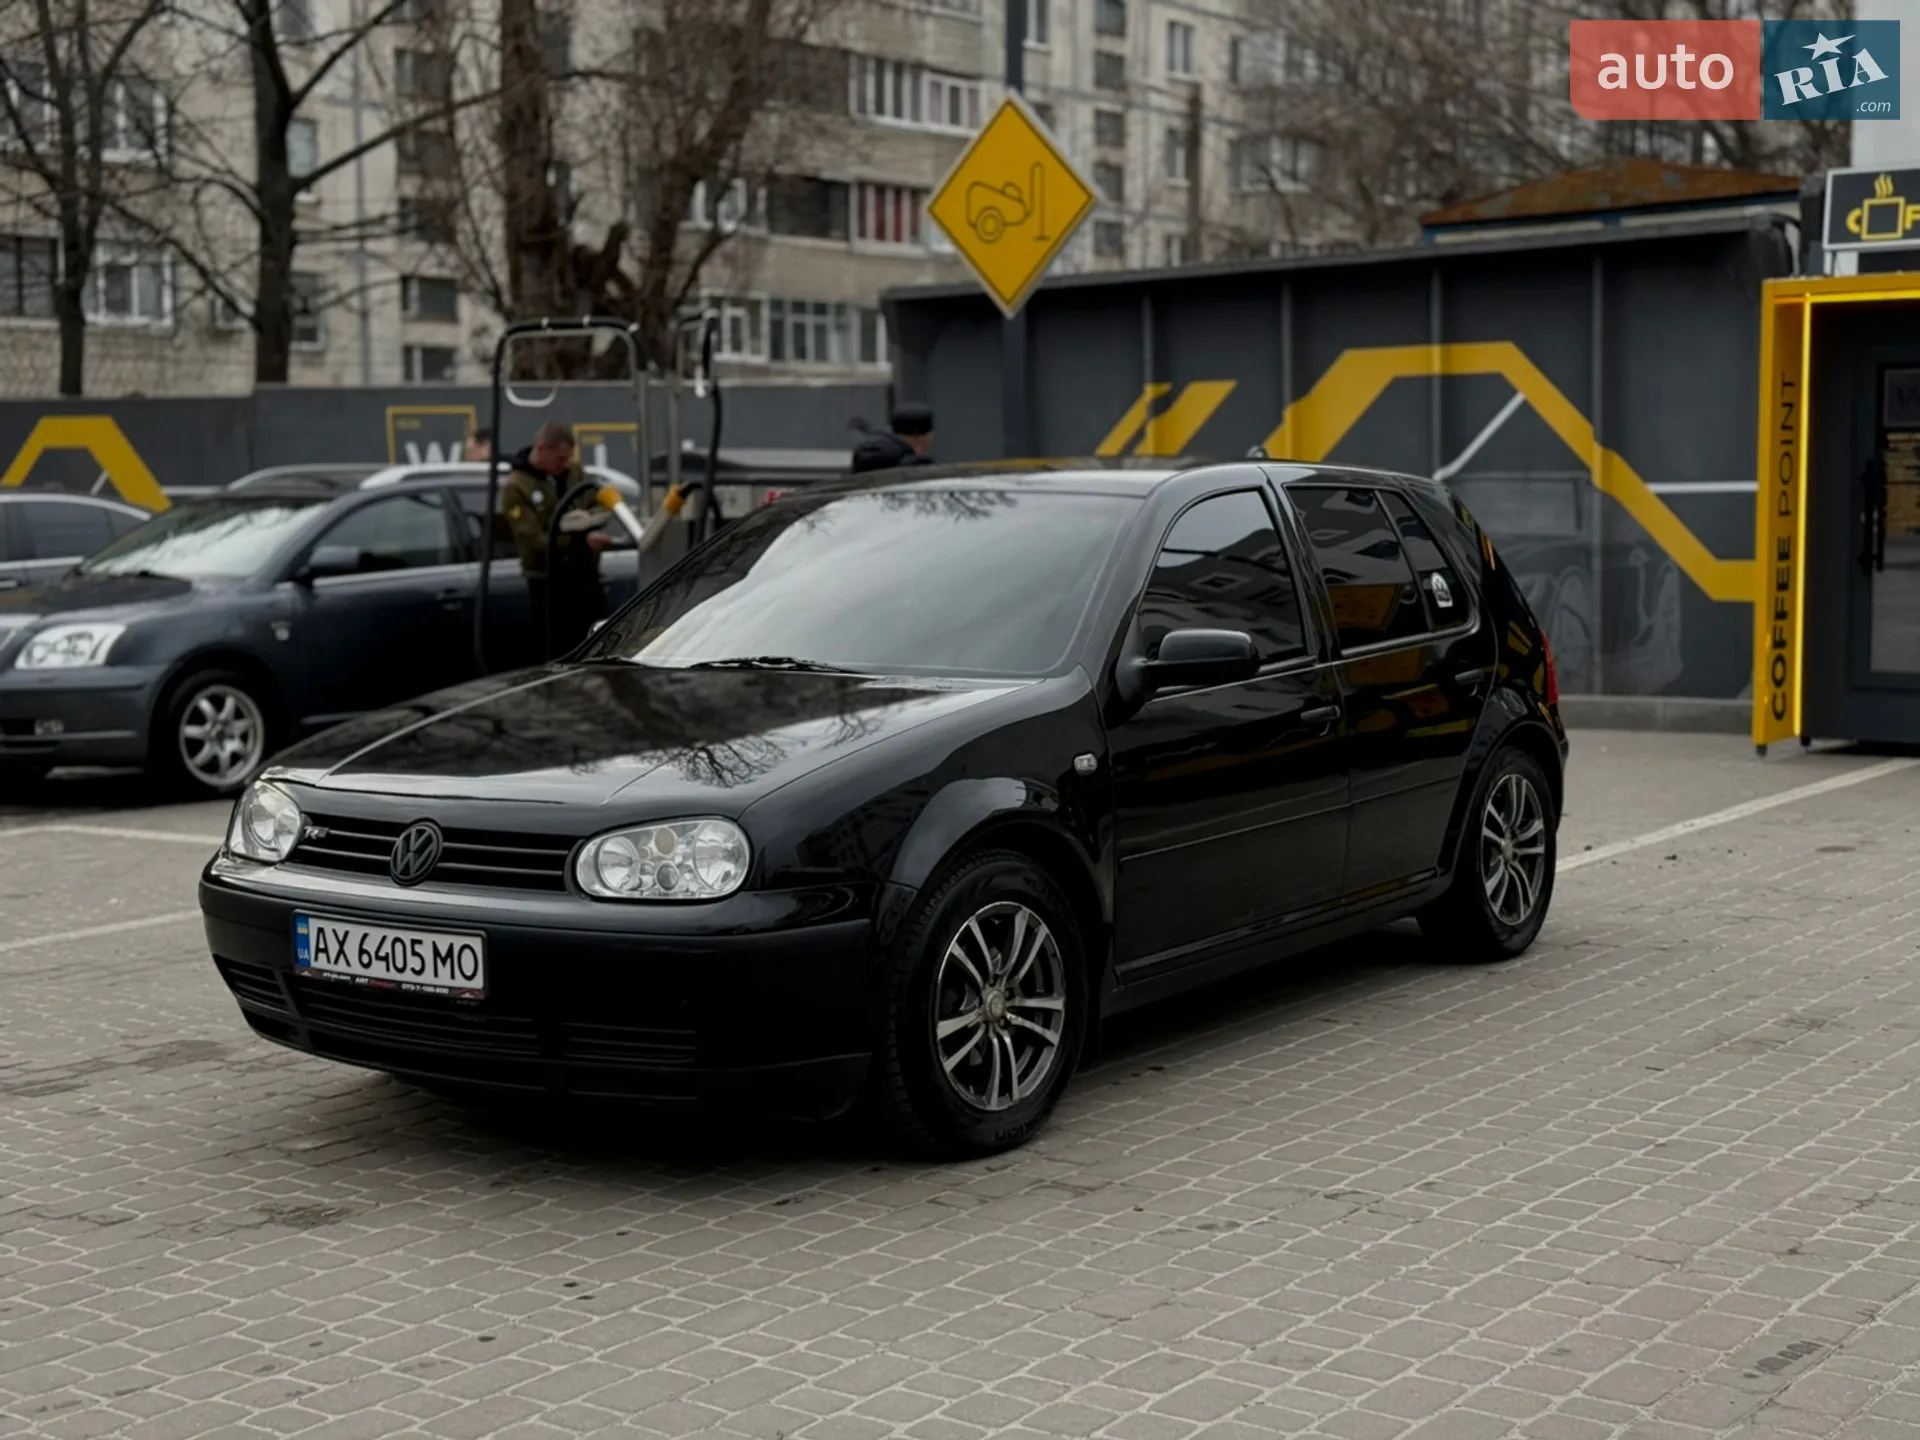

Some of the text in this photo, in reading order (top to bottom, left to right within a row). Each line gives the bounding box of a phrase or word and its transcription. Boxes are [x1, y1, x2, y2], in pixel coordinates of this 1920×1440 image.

[1771, 370, 1796, 721] COFFEE POINT
[297, 947, 310, 961] UA
[314, 926, 479, 981] AX 6405 MO
